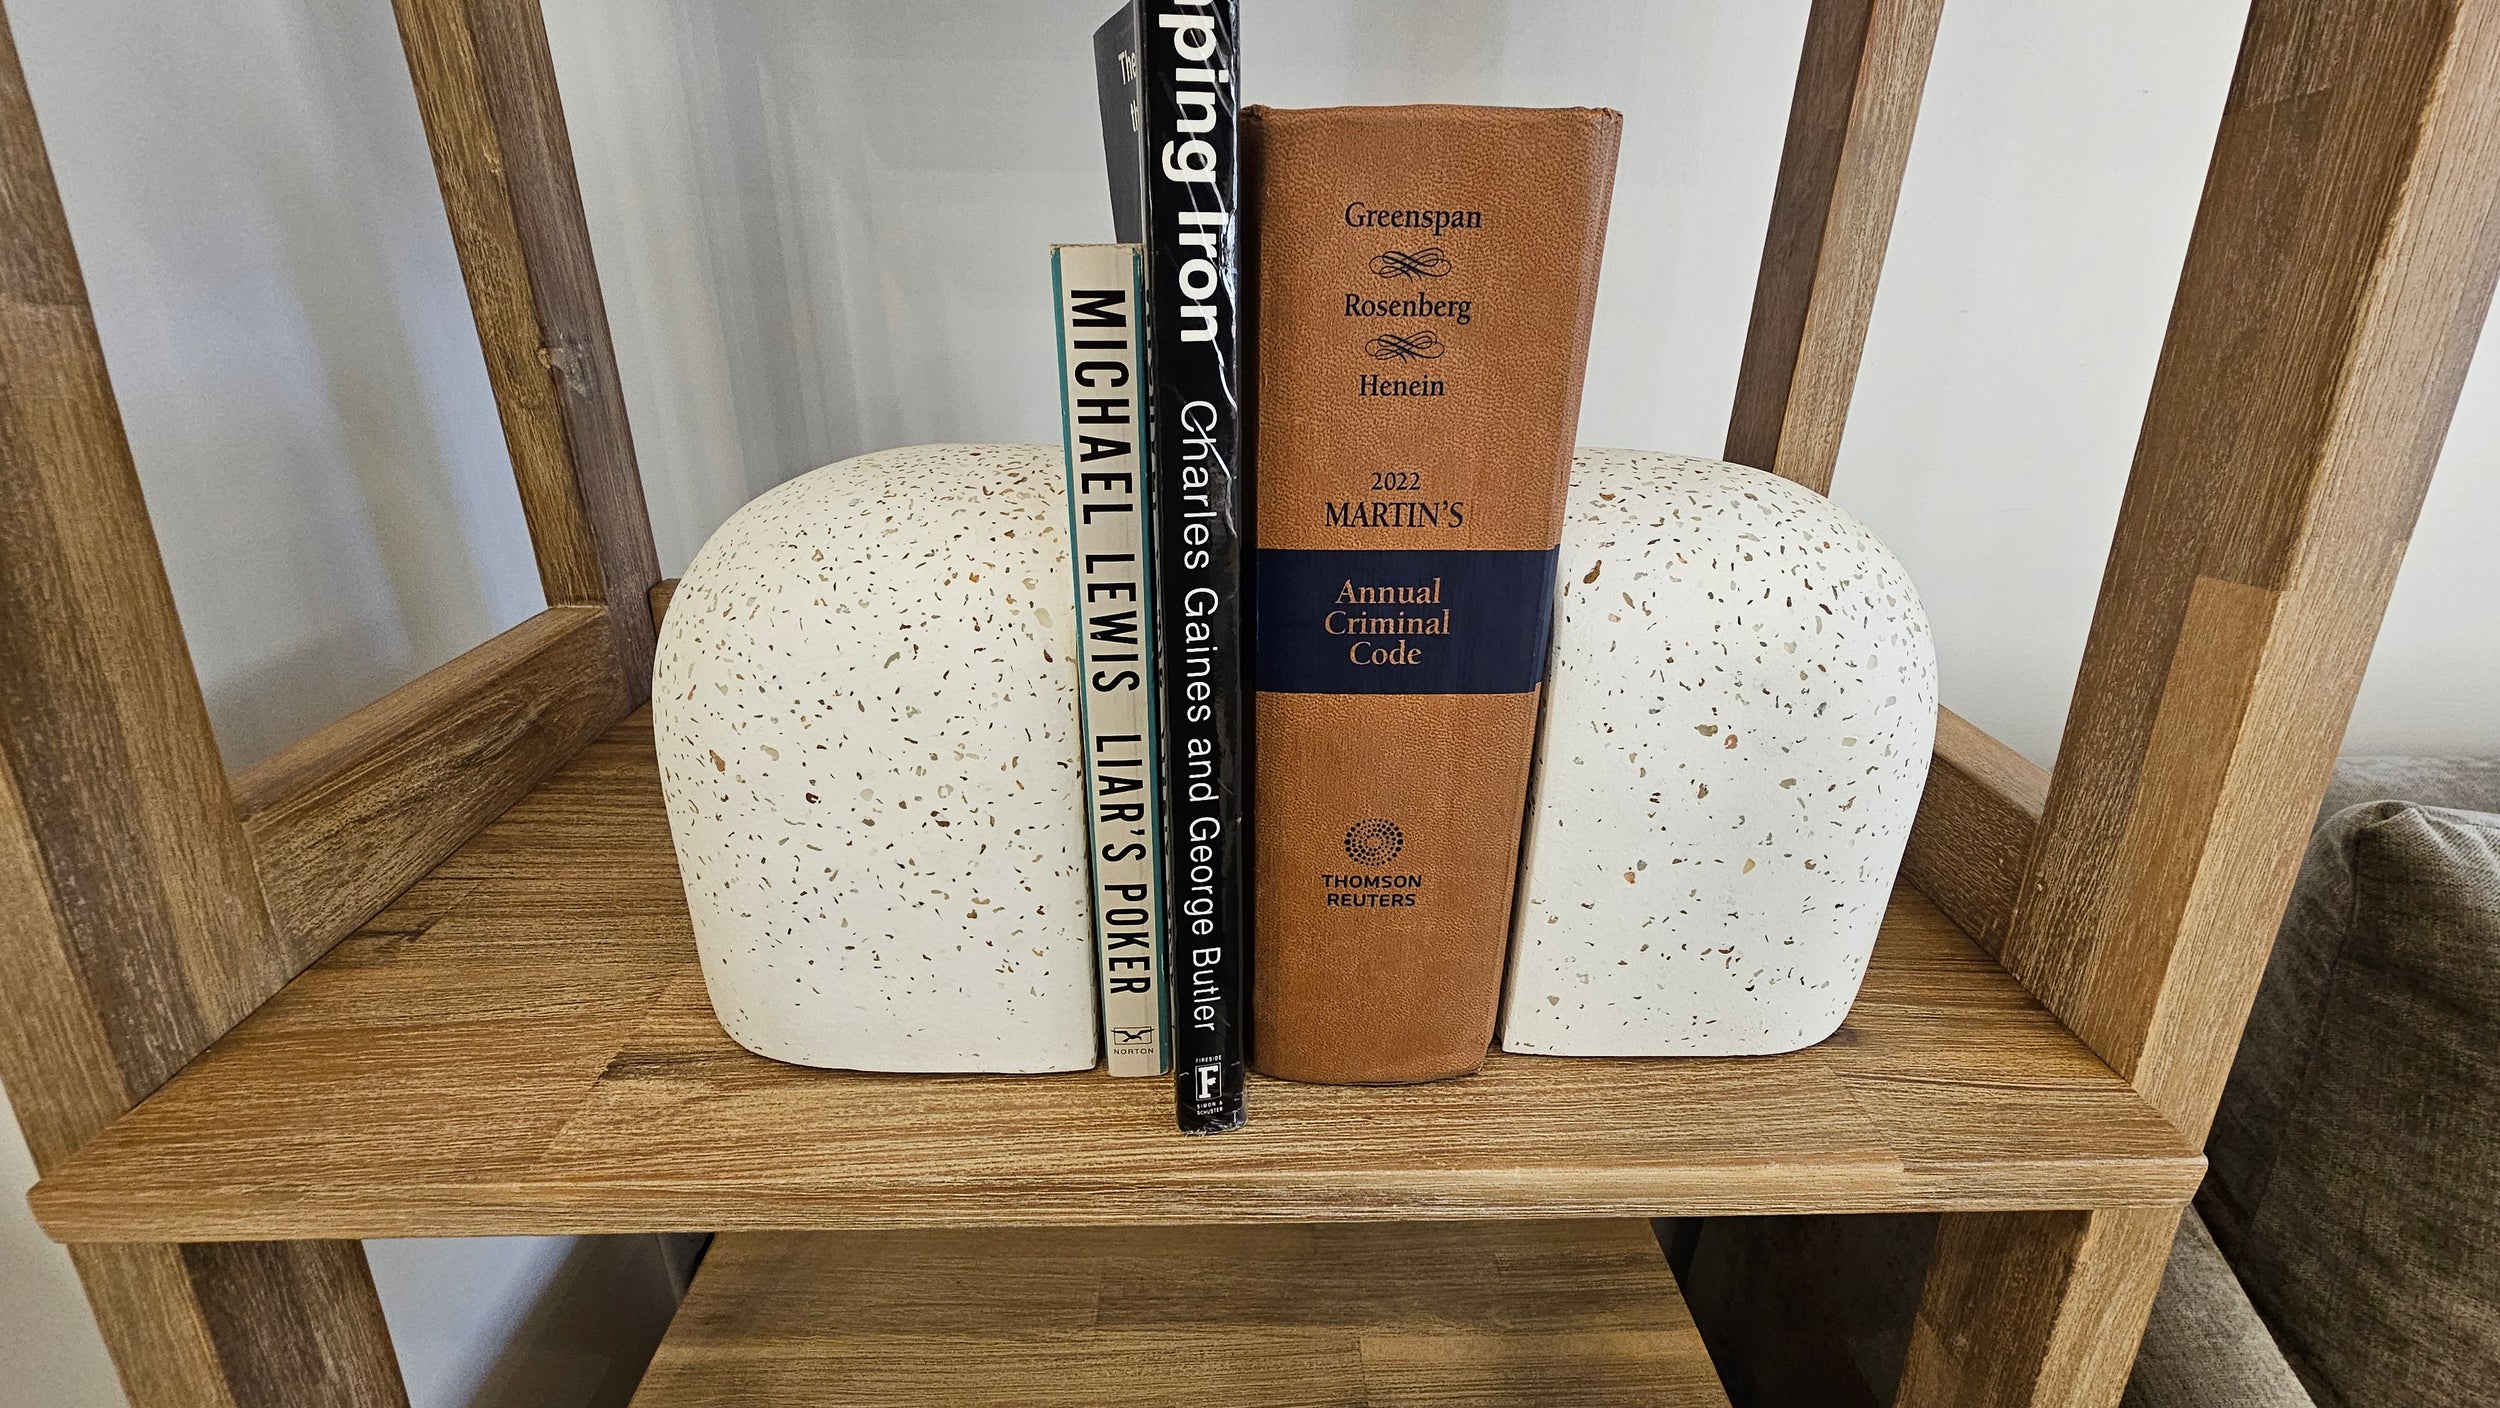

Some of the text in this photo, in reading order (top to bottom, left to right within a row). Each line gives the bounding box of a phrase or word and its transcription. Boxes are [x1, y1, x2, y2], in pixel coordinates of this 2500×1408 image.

[1118, 50, 1137, 84] The
[1344, 202, 1482, 236] Greenspan
[1344, 291, 1472, 325] Rosenberg
[1359, 374, 1445, 397] Henein
[1371, 472, 1420, 490] 2022
[1158, 0, 1229, 1031] ping Iron Charles Gaines and George Butler
[1325, 500, 1464, 528] MARTIN'S
[1335, 577, 1441, 604] Annual
[1324, 608, 1451, 635] Criminal
[1071, 290, 1151, 994] MICHAEL LEWIS LIAR'S POKER
[1349, 639, 1422, 665] Code
[1322, 874, 1422, 888] THOMSON
[1327, 893, 1416, 907] REUTERS
[1113, 1047, 1154, 1055] NORTON
[1195, 1055, 1222, 1064] FIRESIDE
[1198, 1065, 1219, 1099] F
[1196, 1101, 1217, 1110] SIMON
[1196, 1106, 1223, 1116] SCHUSTER
